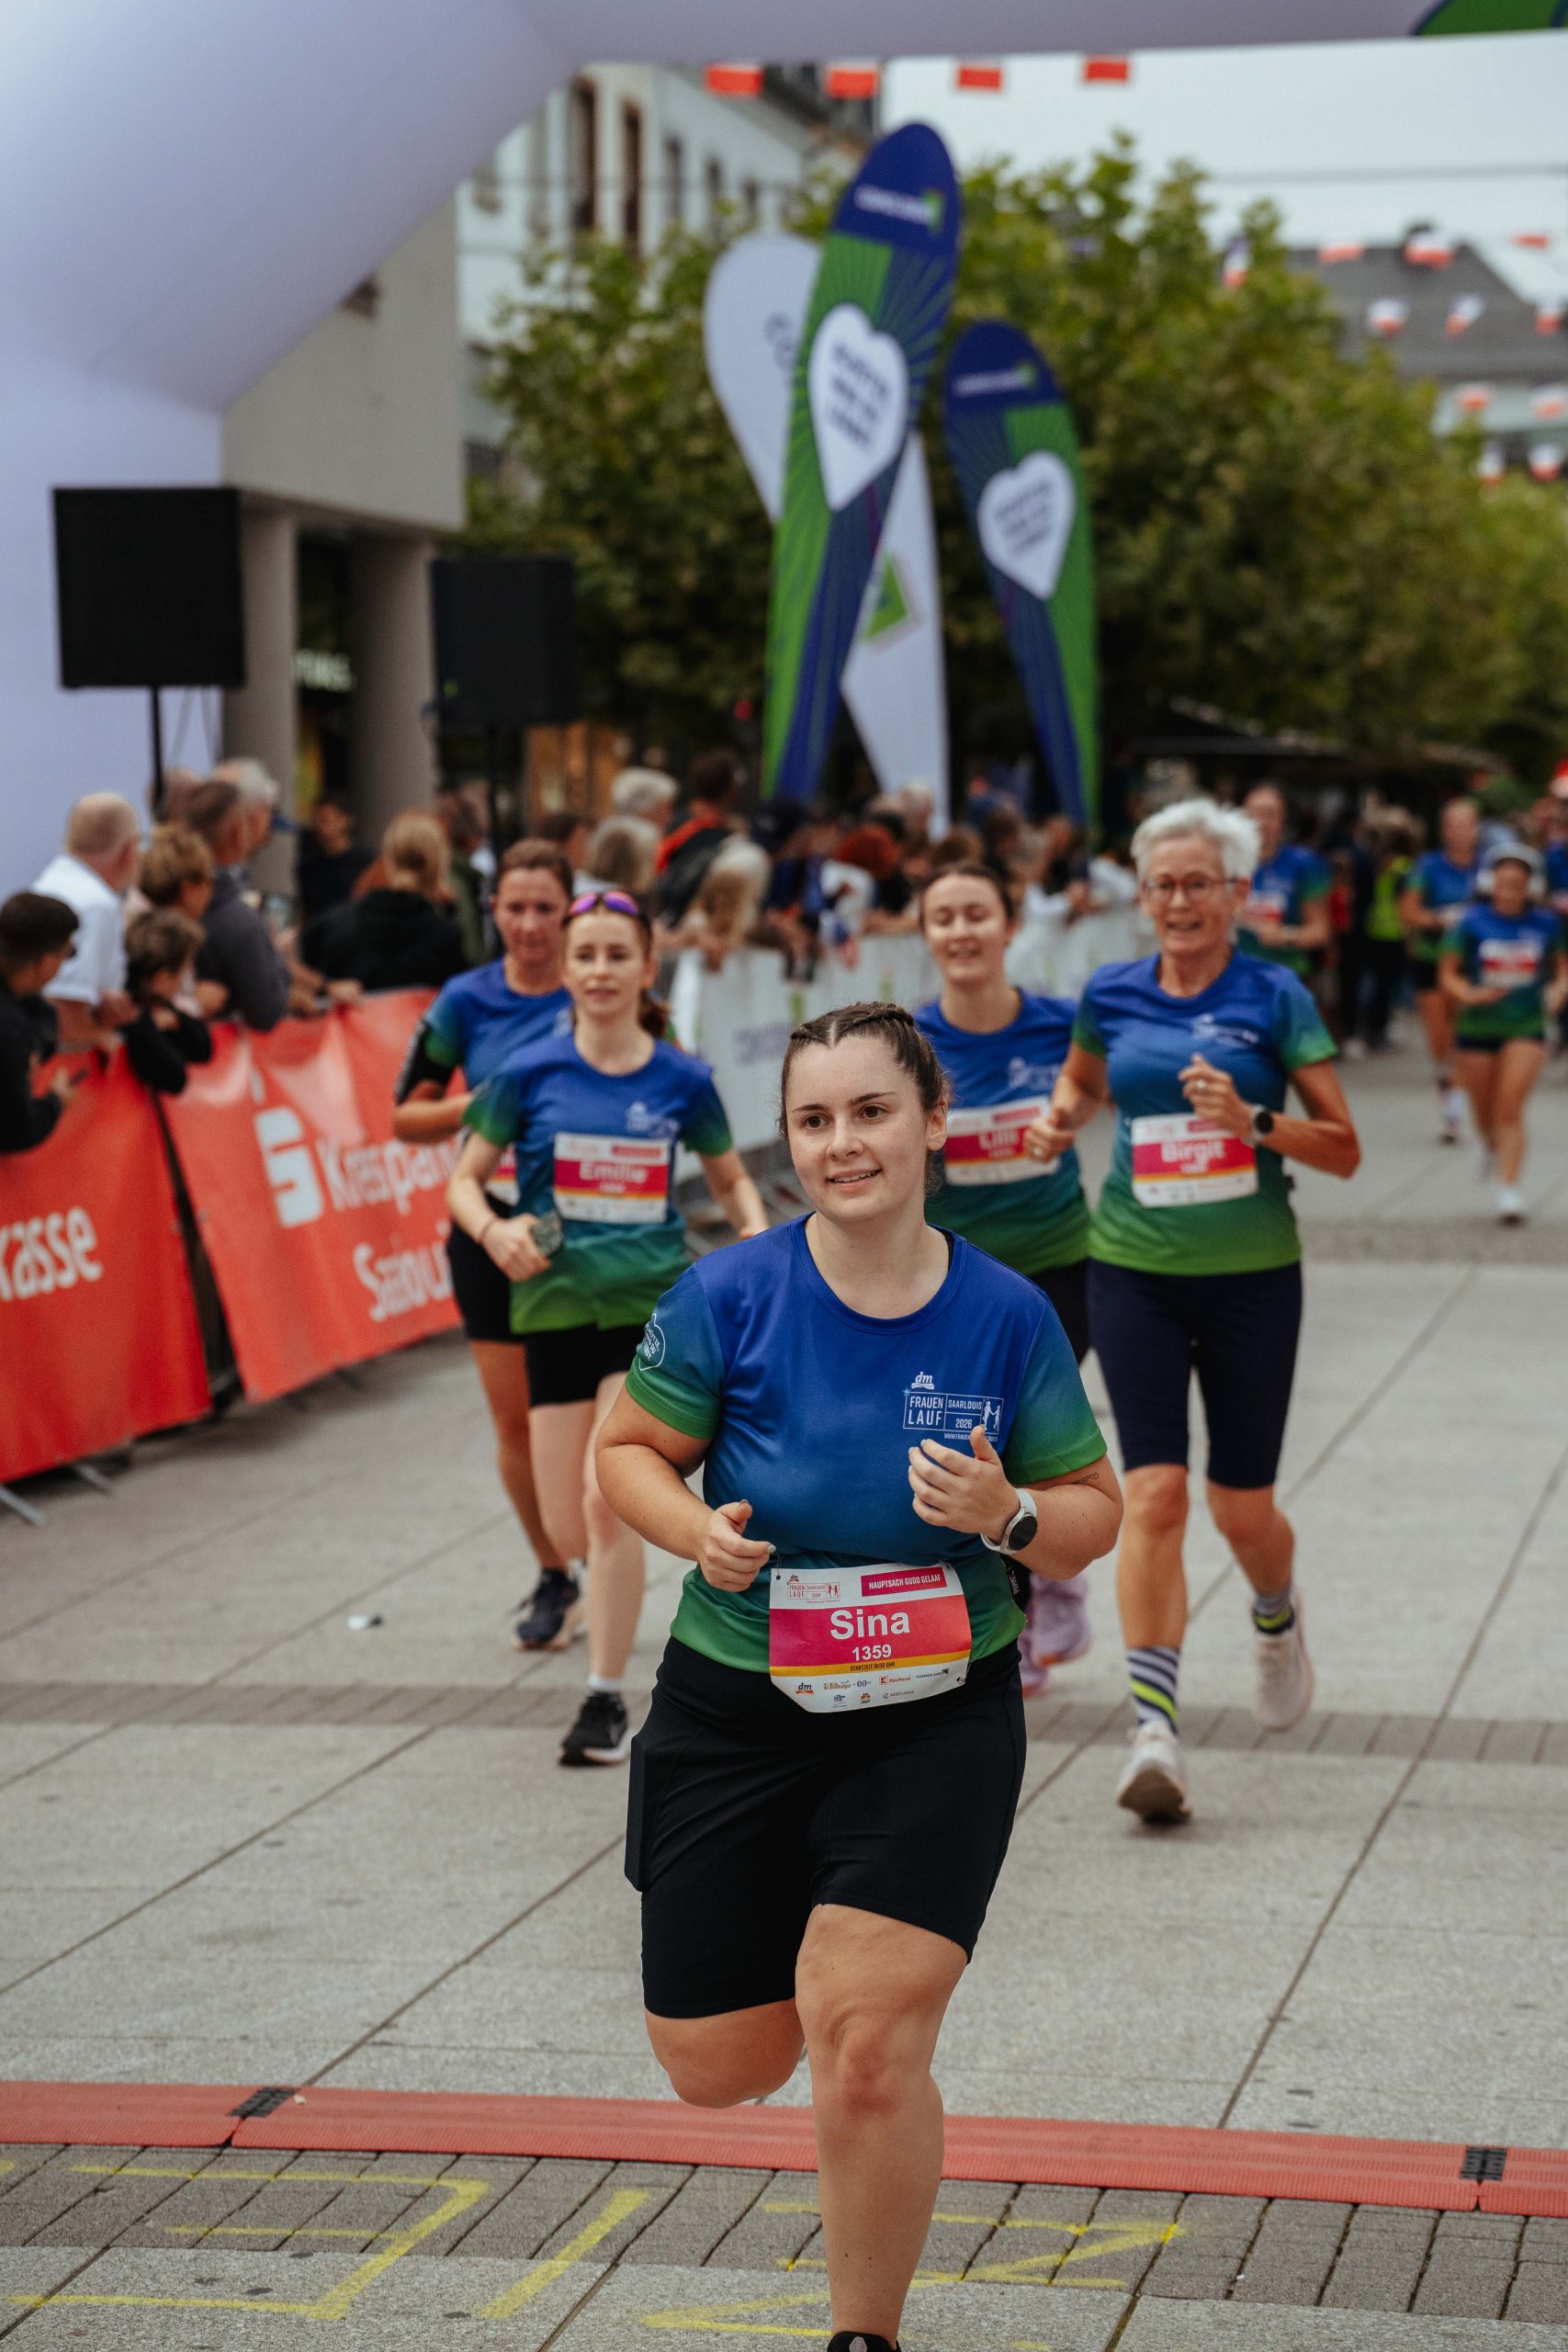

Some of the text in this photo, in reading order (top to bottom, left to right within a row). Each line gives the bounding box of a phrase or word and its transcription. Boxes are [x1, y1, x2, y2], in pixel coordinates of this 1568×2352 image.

[915, 1372, 932, 1384] dm
[909, 1396, 943, 1409] FRAUEN
[948, 1399, 982, 1410] SAARLOUIS
[908, 1409, 942, 1425] LAUF
[869, 1574, 941, 1589] HAUPTSACH GUDD GELAAF
[829, 1609, 910, 1640] Sina
[852, 1644, 892, 1661] 1359
